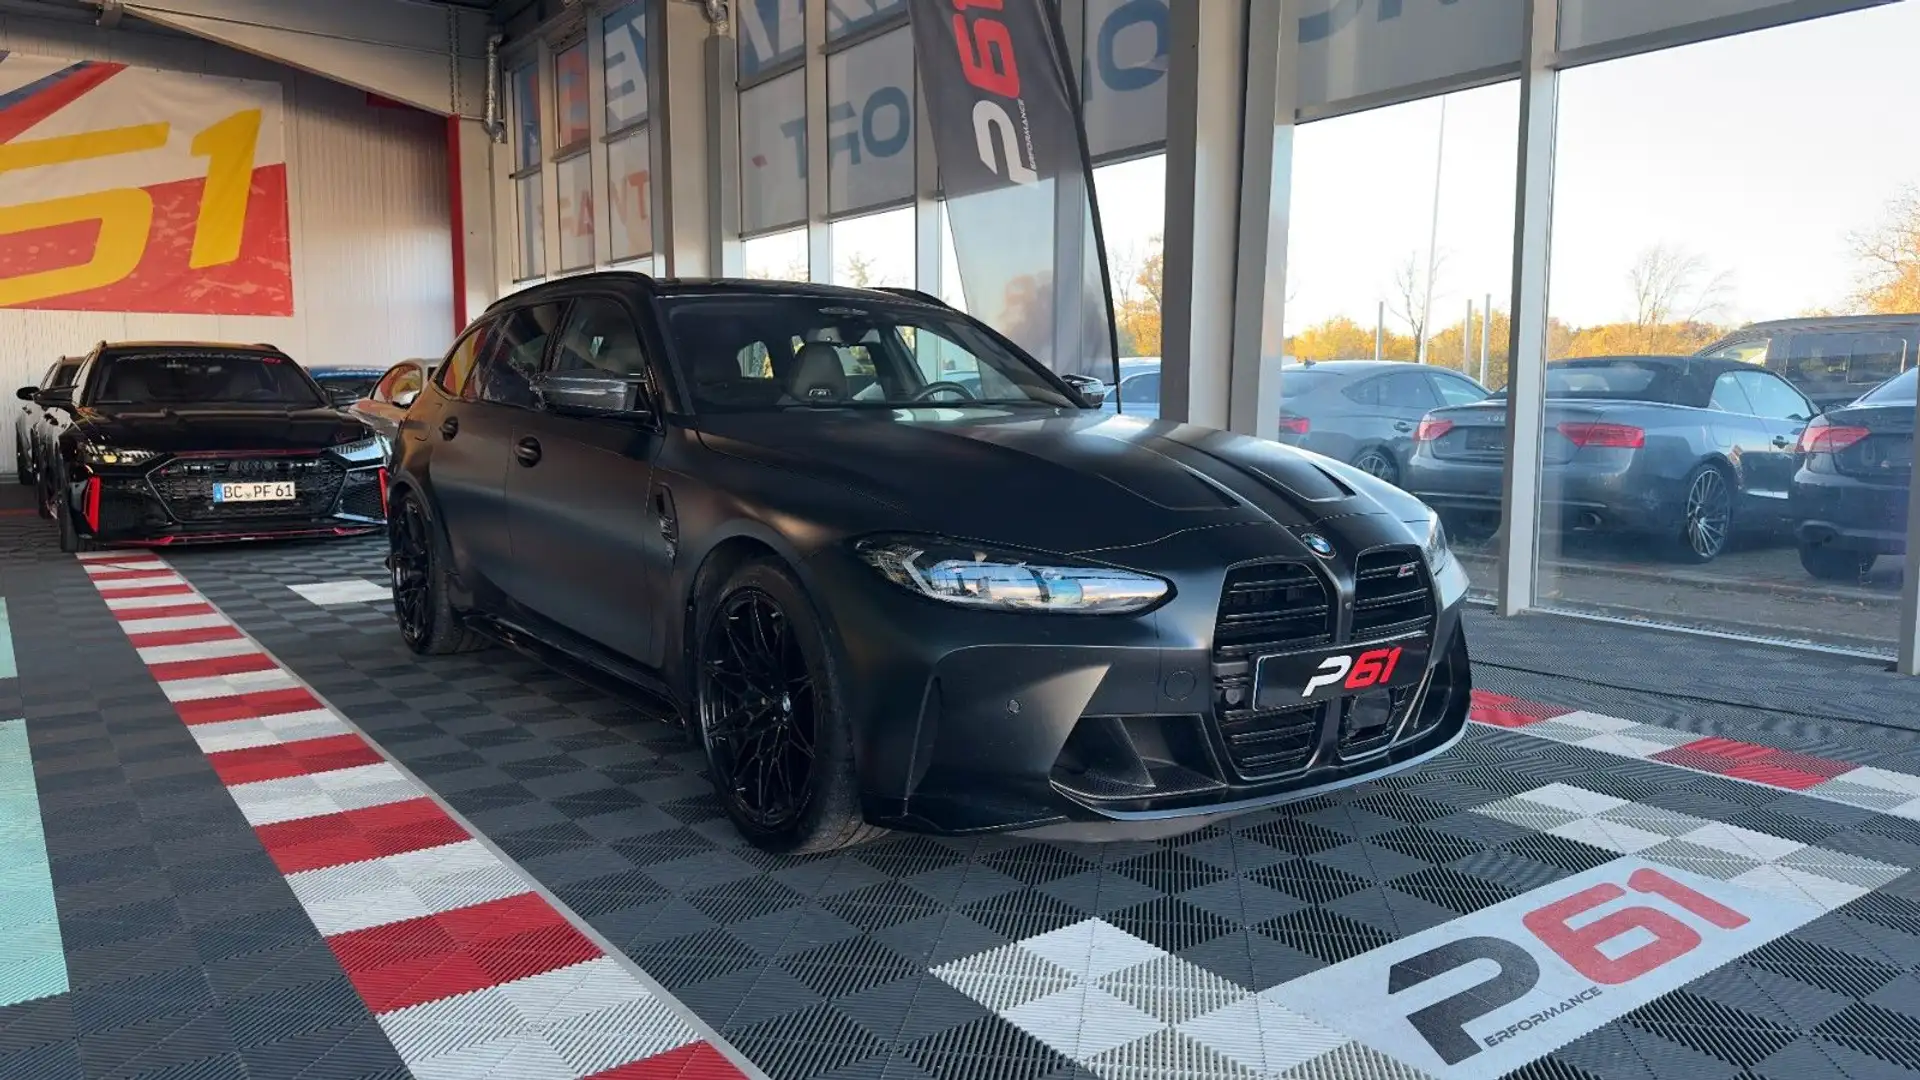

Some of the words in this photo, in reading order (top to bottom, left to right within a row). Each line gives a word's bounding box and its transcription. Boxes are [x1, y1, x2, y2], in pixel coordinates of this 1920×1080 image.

[223, 485, 243, 499] BC
[253, 484, 271, 498] PF
[275, 484, 293, 497] 61
[1302, 647, 1402, 697] P61
